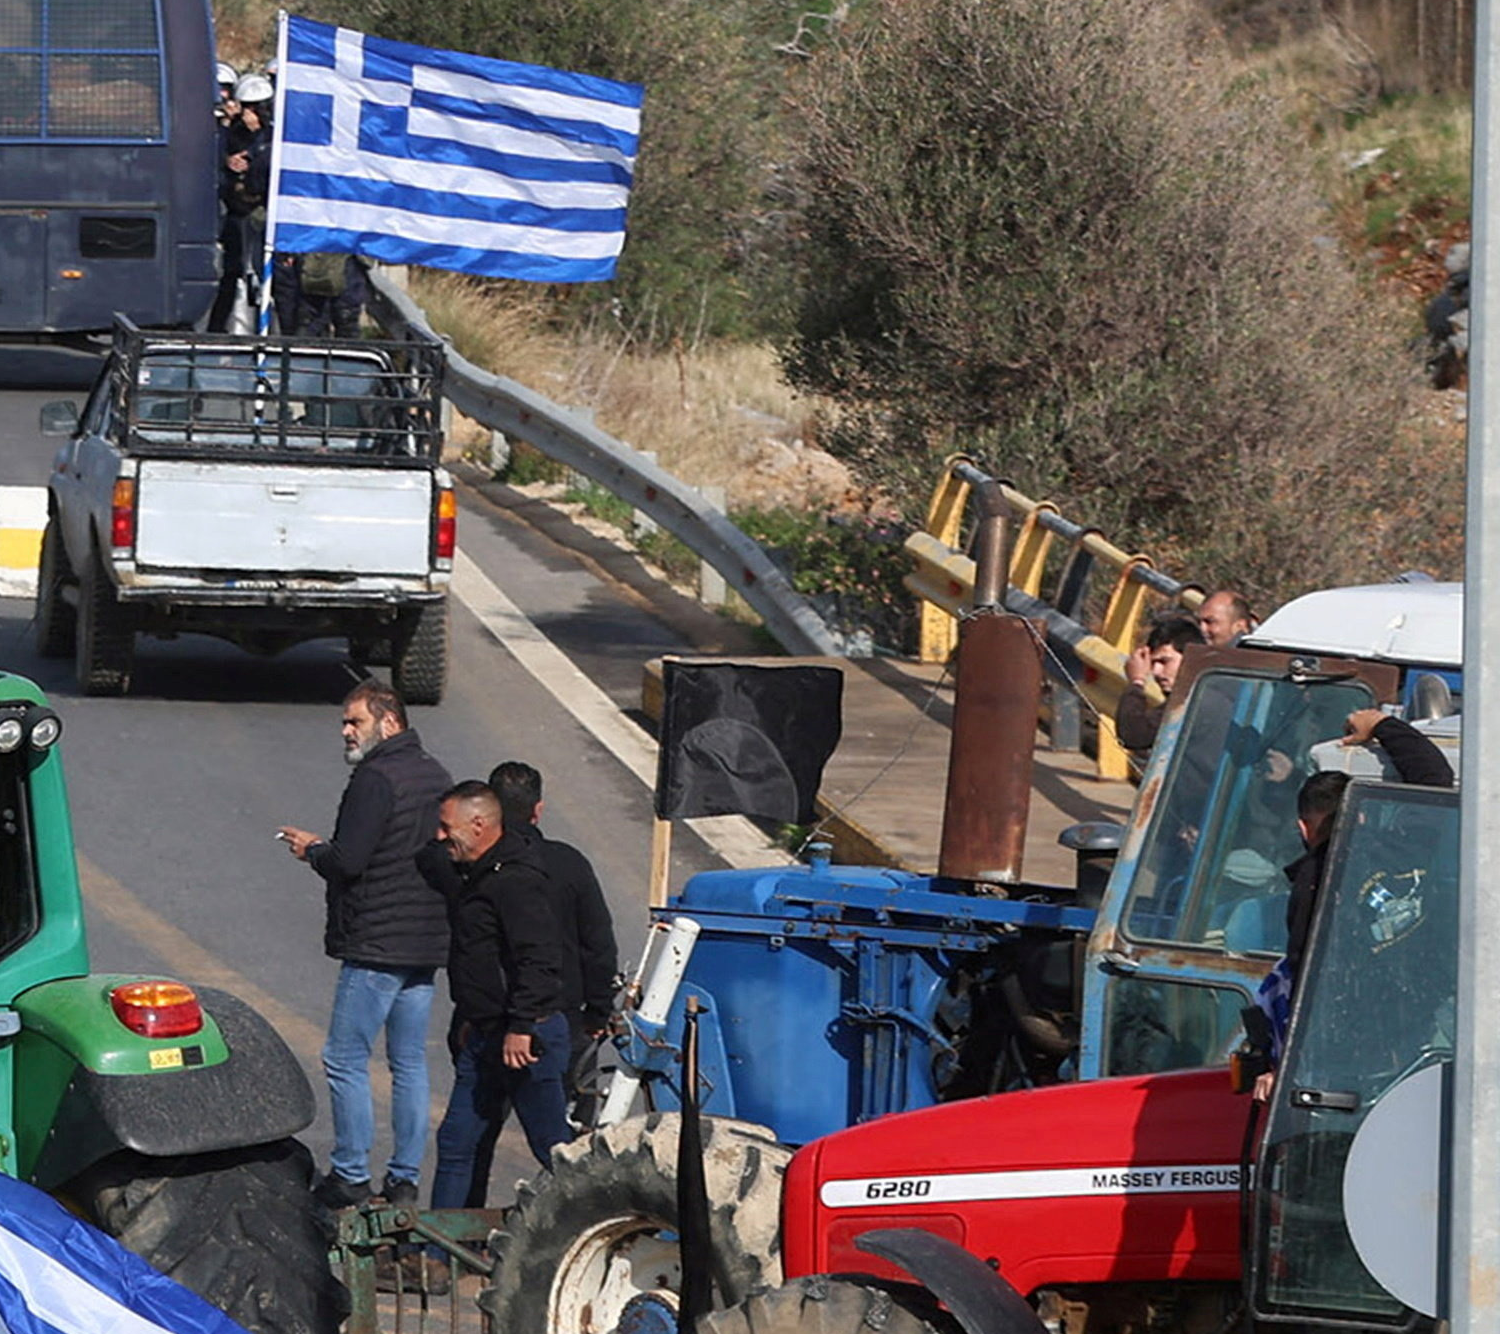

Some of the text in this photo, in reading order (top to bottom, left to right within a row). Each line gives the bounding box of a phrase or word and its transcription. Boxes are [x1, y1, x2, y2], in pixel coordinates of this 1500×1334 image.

[866, 1169, 1241, 1200] 6280 MASSEY FERGUS
